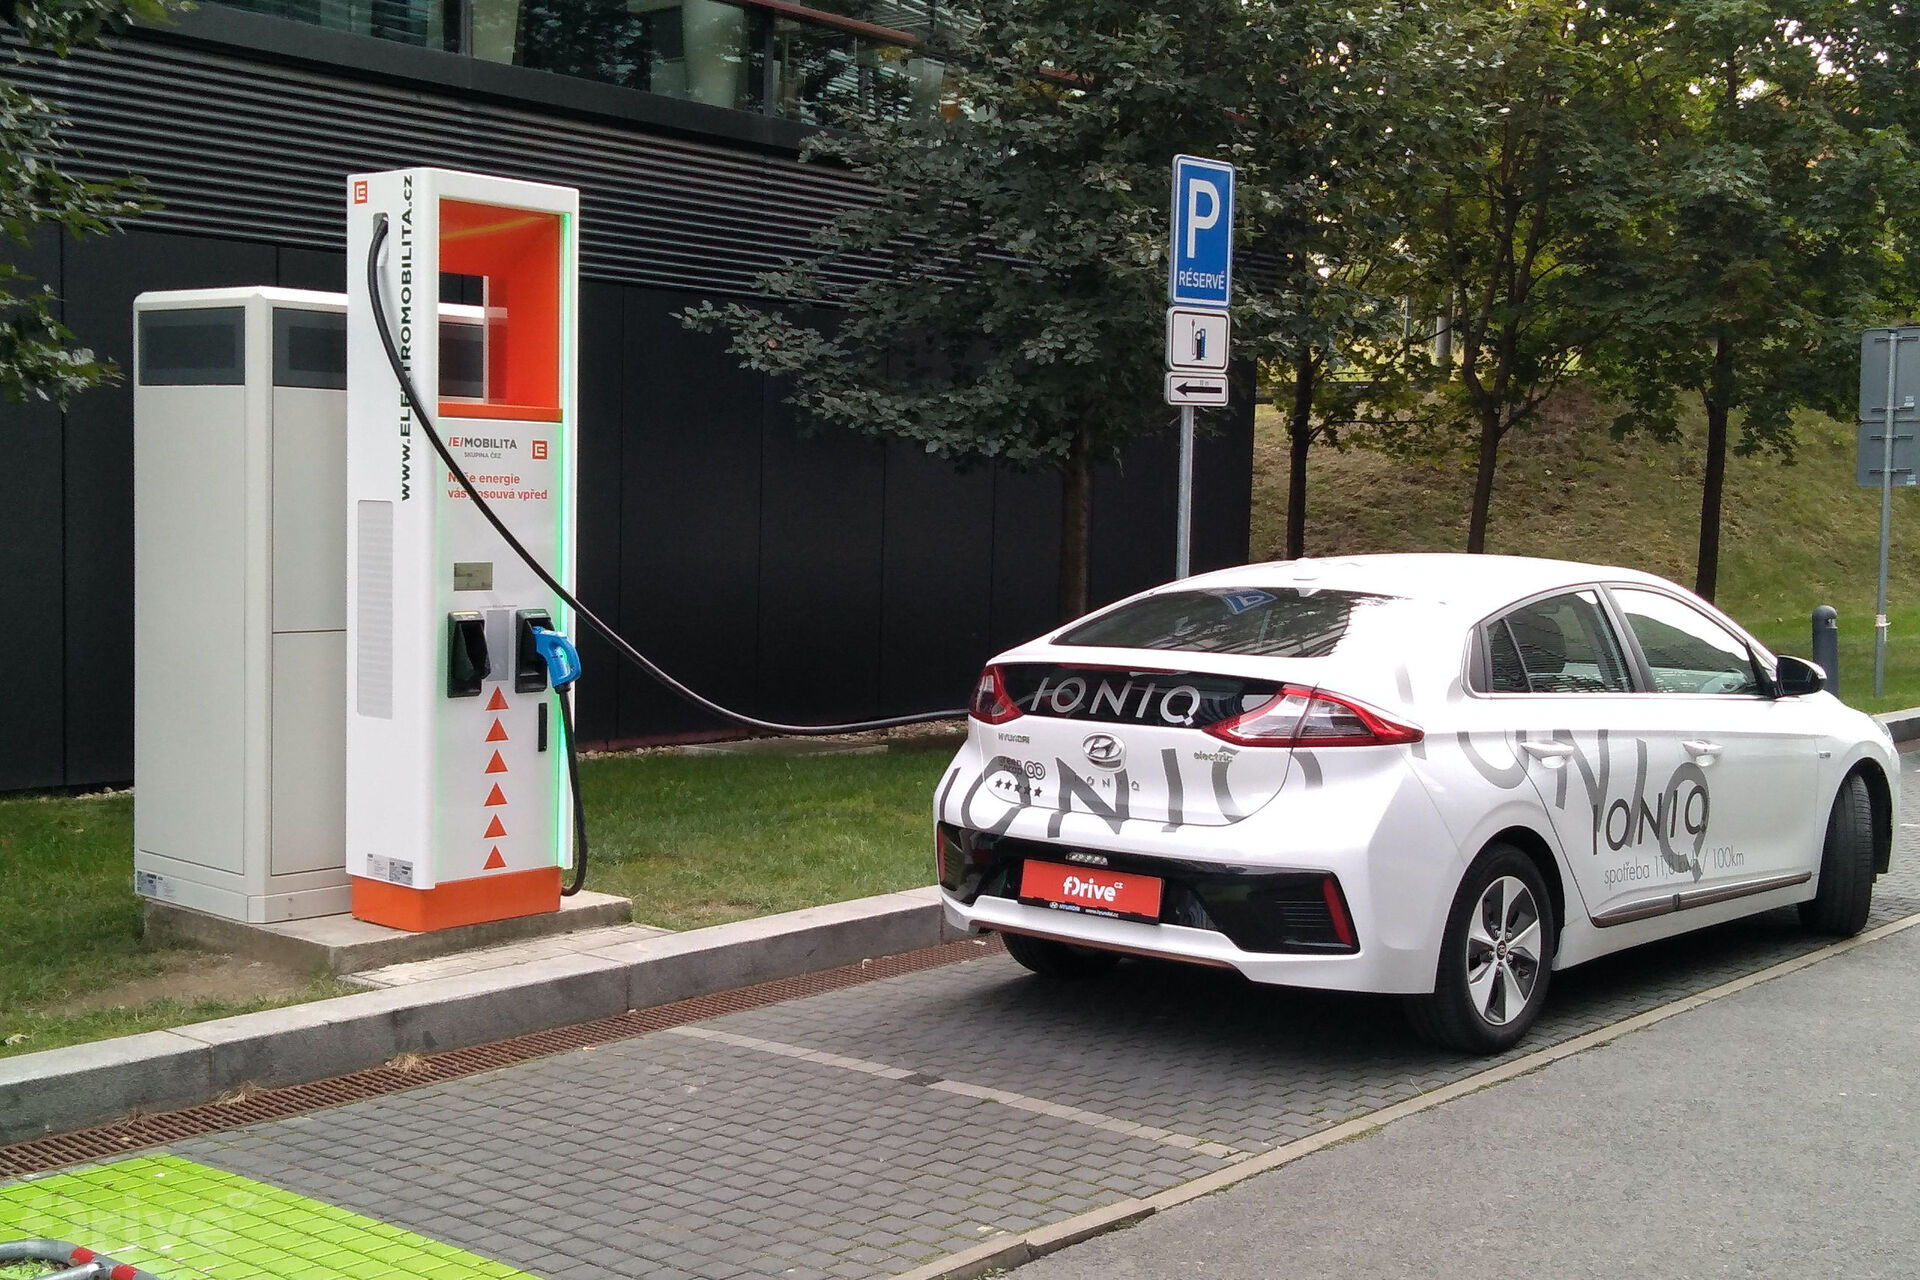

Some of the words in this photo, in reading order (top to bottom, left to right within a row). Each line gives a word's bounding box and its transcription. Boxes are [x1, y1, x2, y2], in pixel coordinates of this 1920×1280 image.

[1187, 178, 1220, 259] P
[1178, 267, 1225, 290] RÉSERVÉ
[448, 471, 476, 483] Ne
[479, 473, 520, 486] energie
[469, 488, 515, 500] osouvá
[517, 488, 548, 501] vpřed
[1031, 677, 1200, 725] IONIQ
[1193, 750, 1233, 763] electric
[1592, 785, 1708, 855] IONIQ
[1603, 856, 1650, 890] spotřeba
